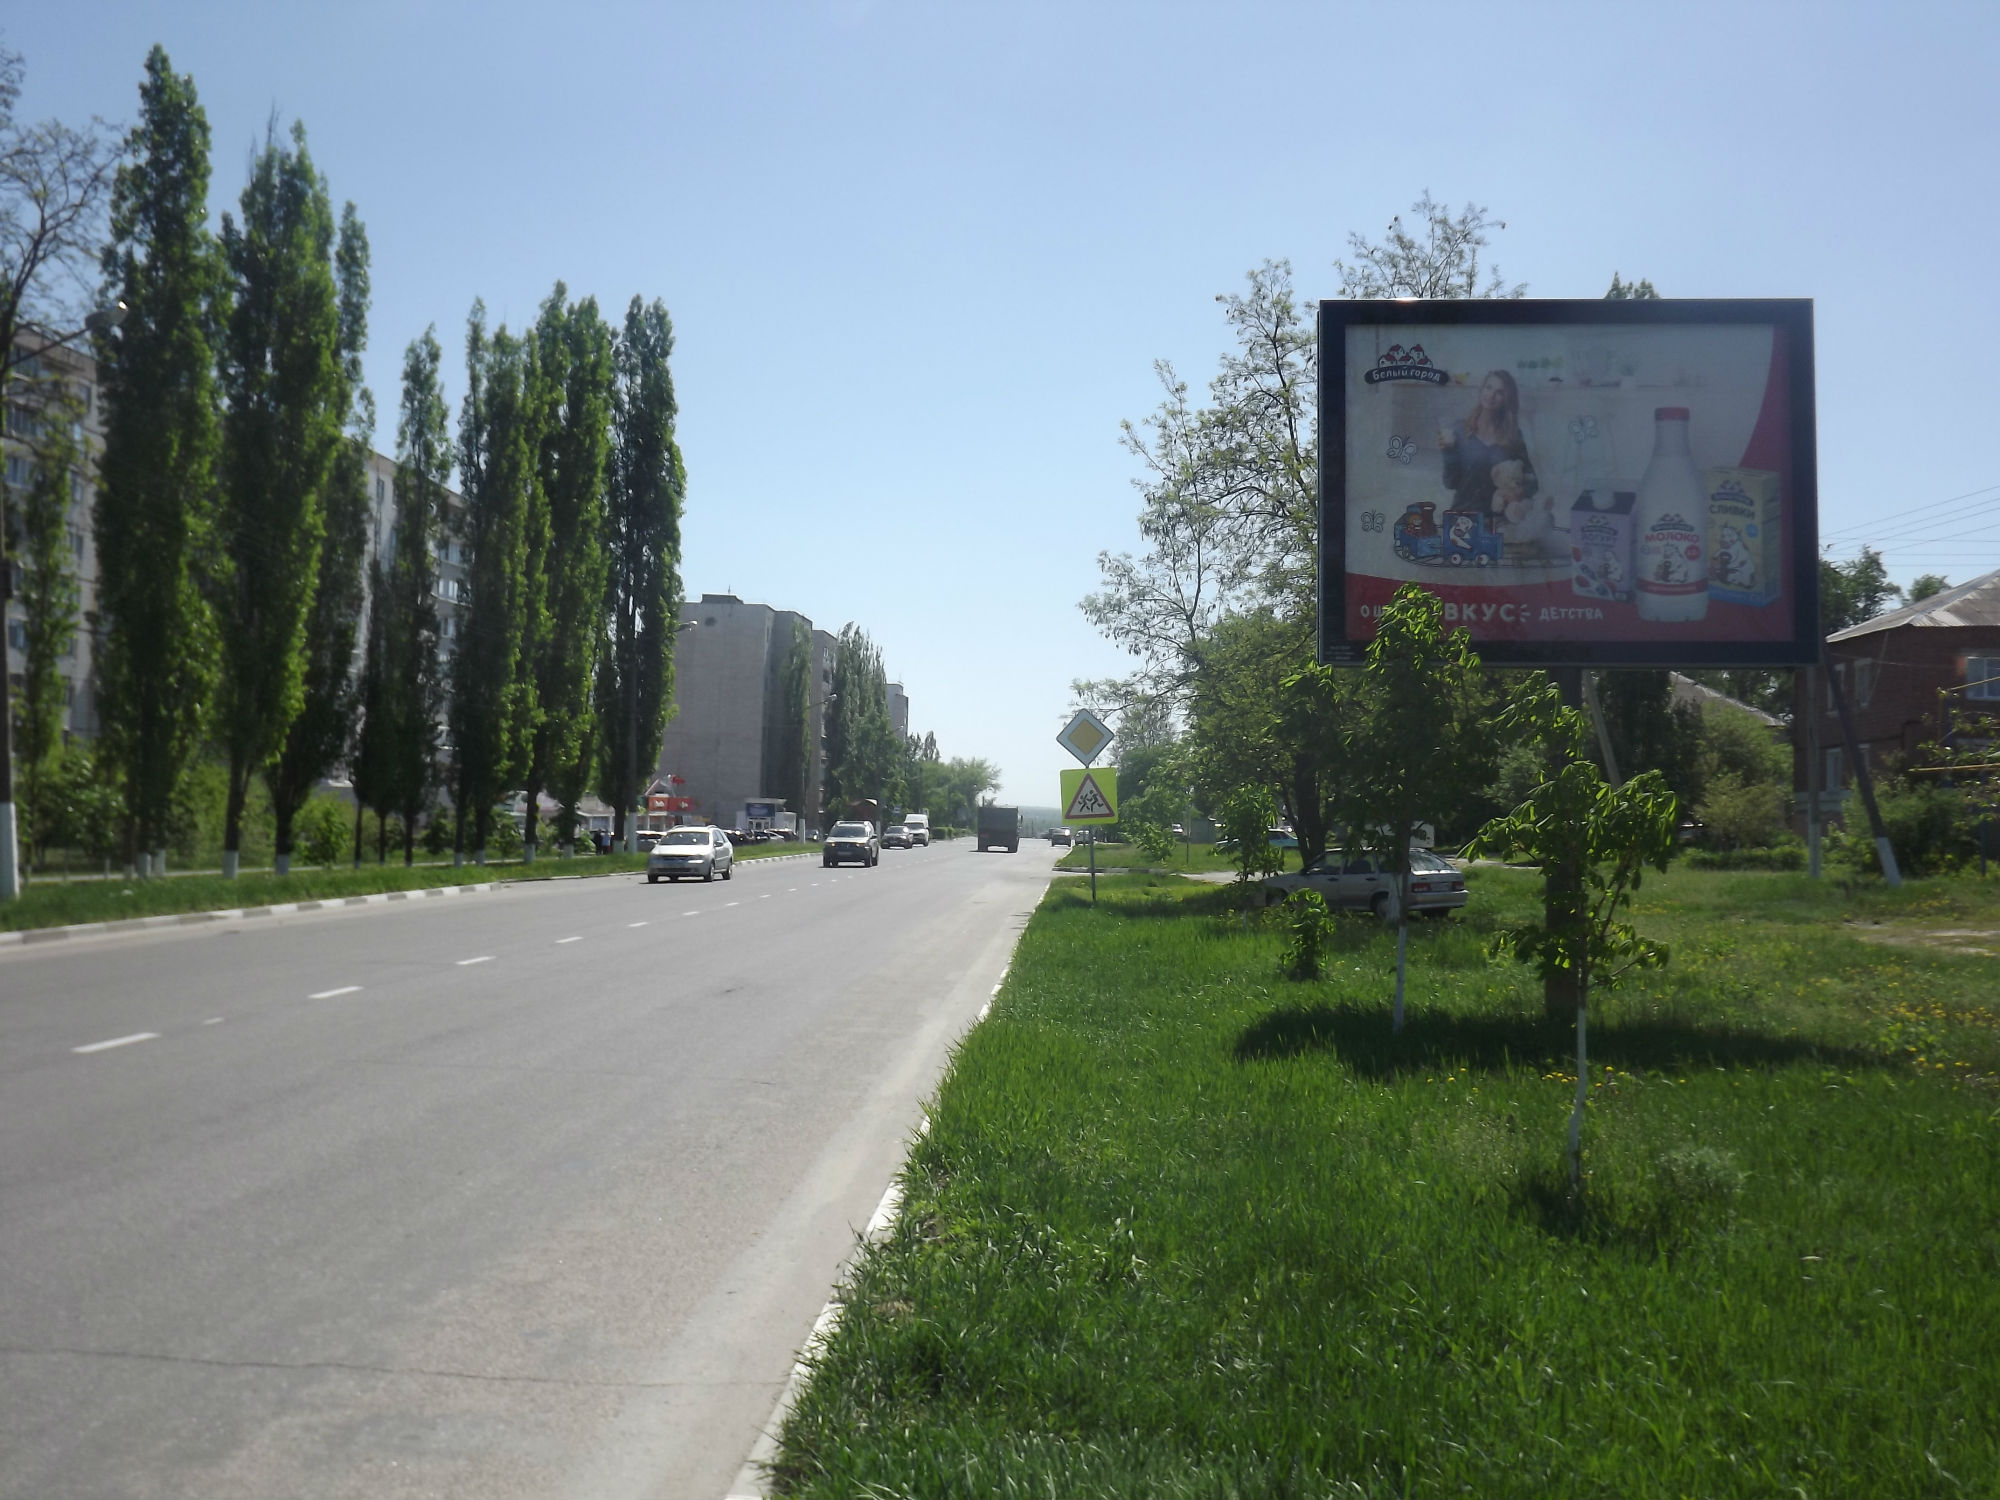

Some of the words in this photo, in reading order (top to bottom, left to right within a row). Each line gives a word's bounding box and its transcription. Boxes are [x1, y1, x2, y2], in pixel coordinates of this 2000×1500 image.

[1410, 369, 1441, 382] город
[1645, 531, 1700, 543] МОЛОКО
[1445, 603, 1515, 621] ВКУС
[1539, 607, 1603, 620] ДЕТСТВА
